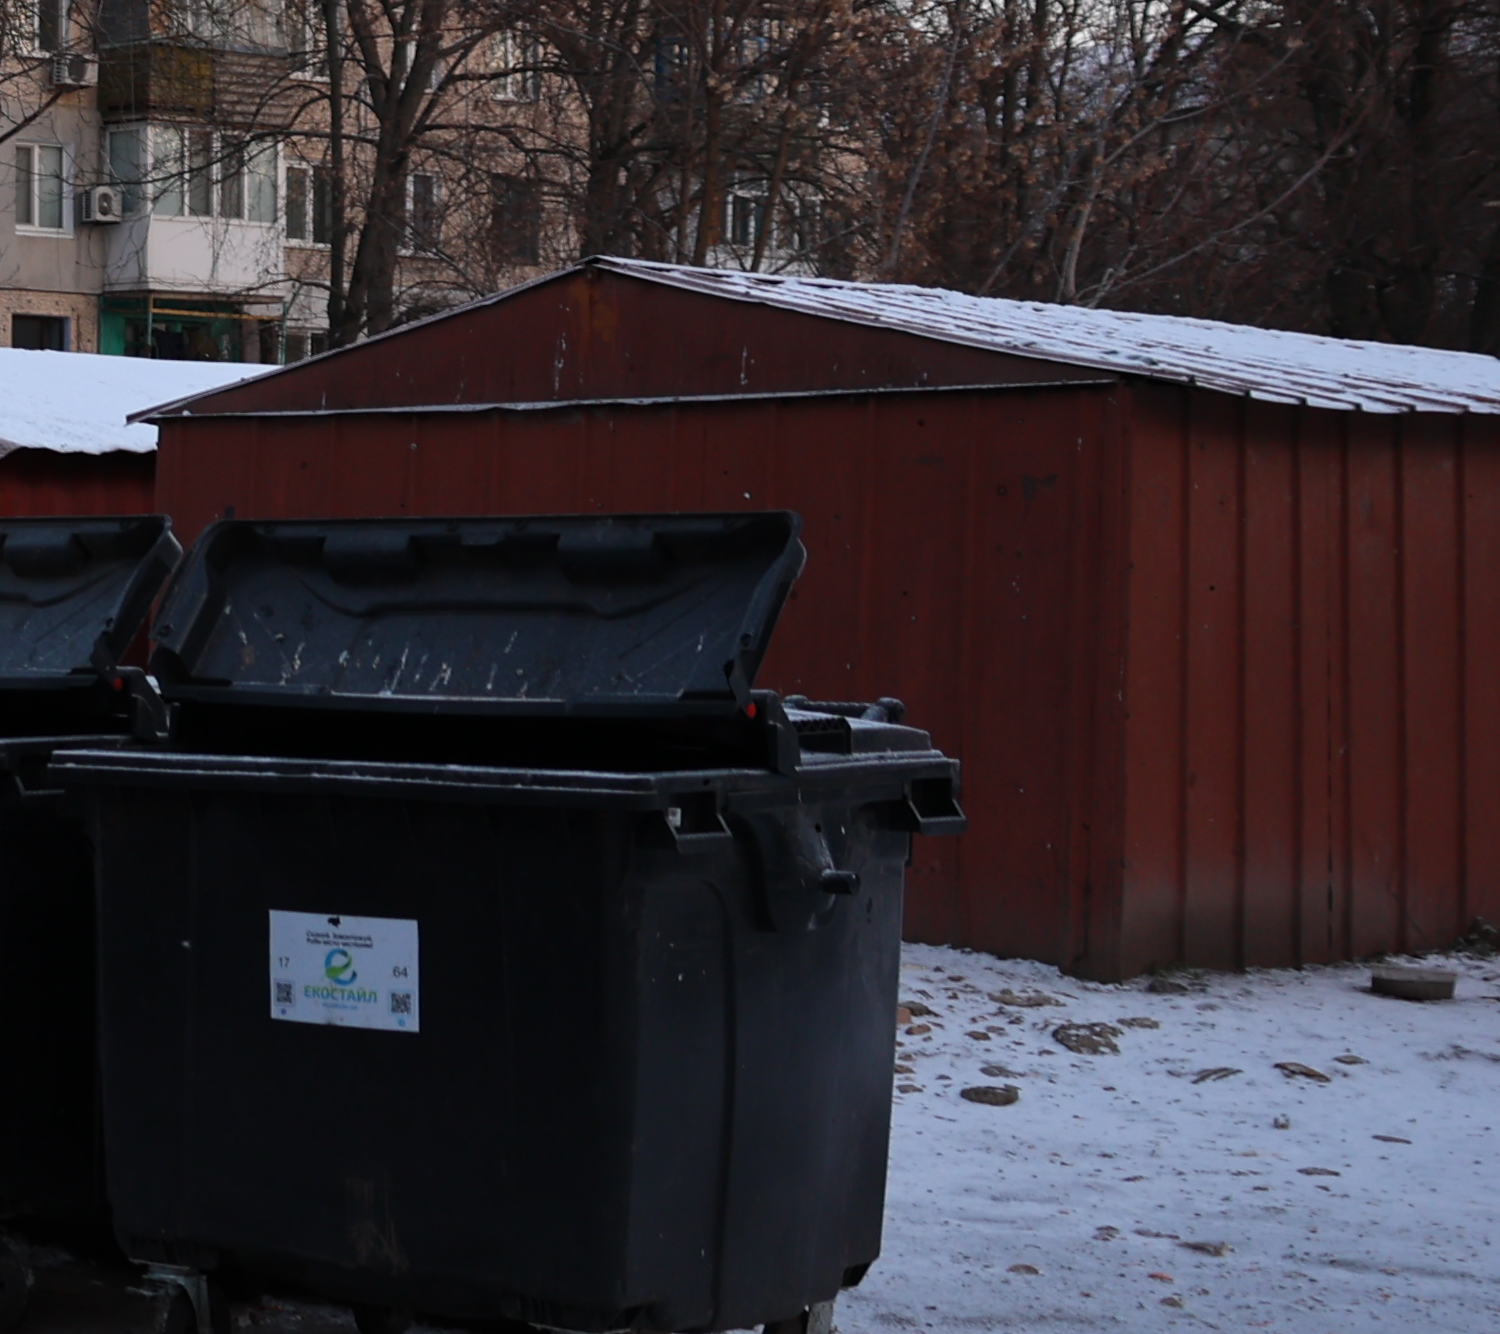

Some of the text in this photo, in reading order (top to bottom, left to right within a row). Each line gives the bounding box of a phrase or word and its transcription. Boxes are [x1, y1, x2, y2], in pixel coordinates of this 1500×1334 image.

[279, 957, 290, 967] 17
[393, 967, 408, 978] 64
[303, 985, 378, 1003] ЕКОСТАЙЛ
